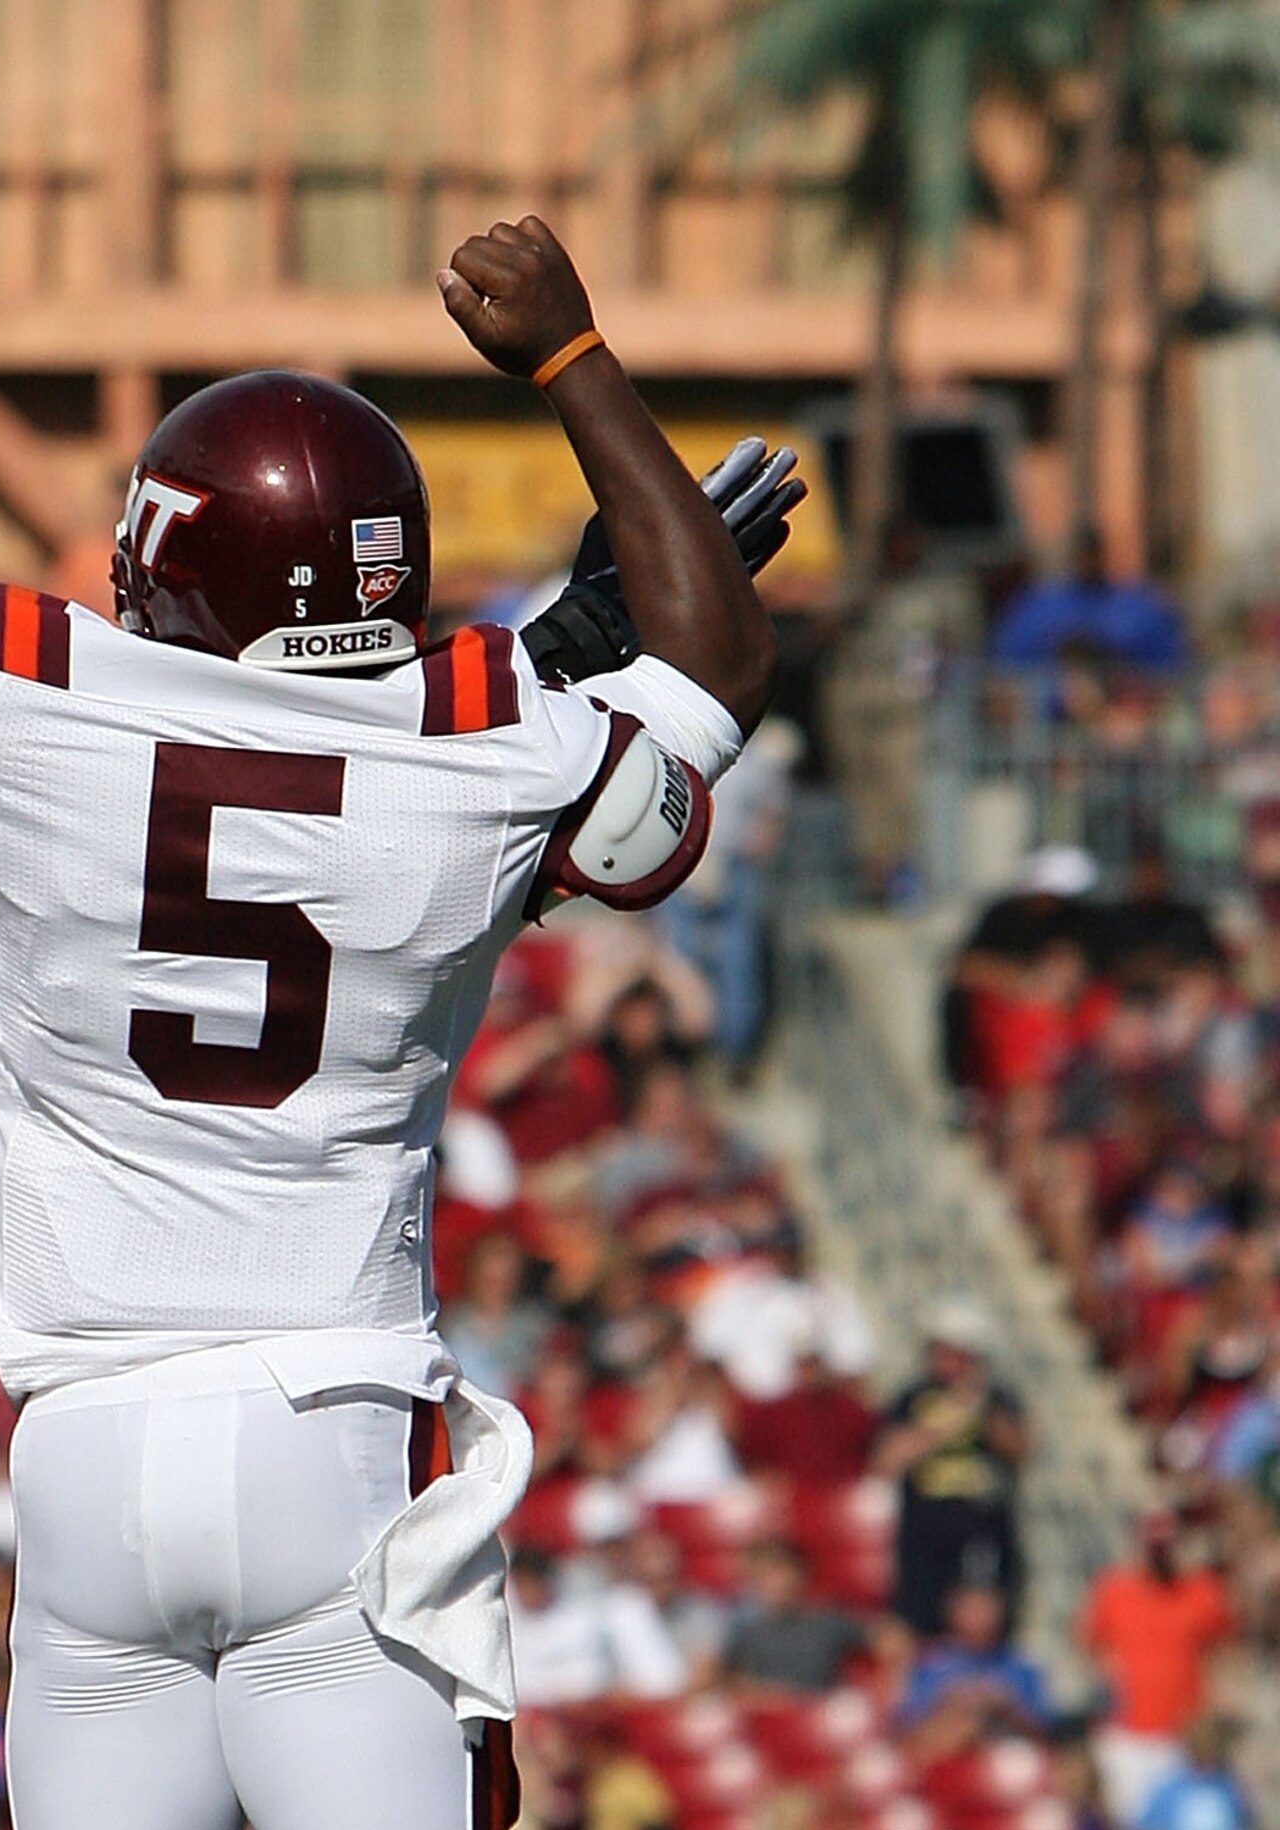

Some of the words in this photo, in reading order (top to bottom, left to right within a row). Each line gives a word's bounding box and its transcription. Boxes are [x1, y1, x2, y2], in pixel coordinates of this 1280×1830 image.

[288, 565, 313, 587] JD
[365, 575, 396, 594] ACC
[282, 627, 392, 658] HOKIES
[127, 740, 347, 1110] 5
